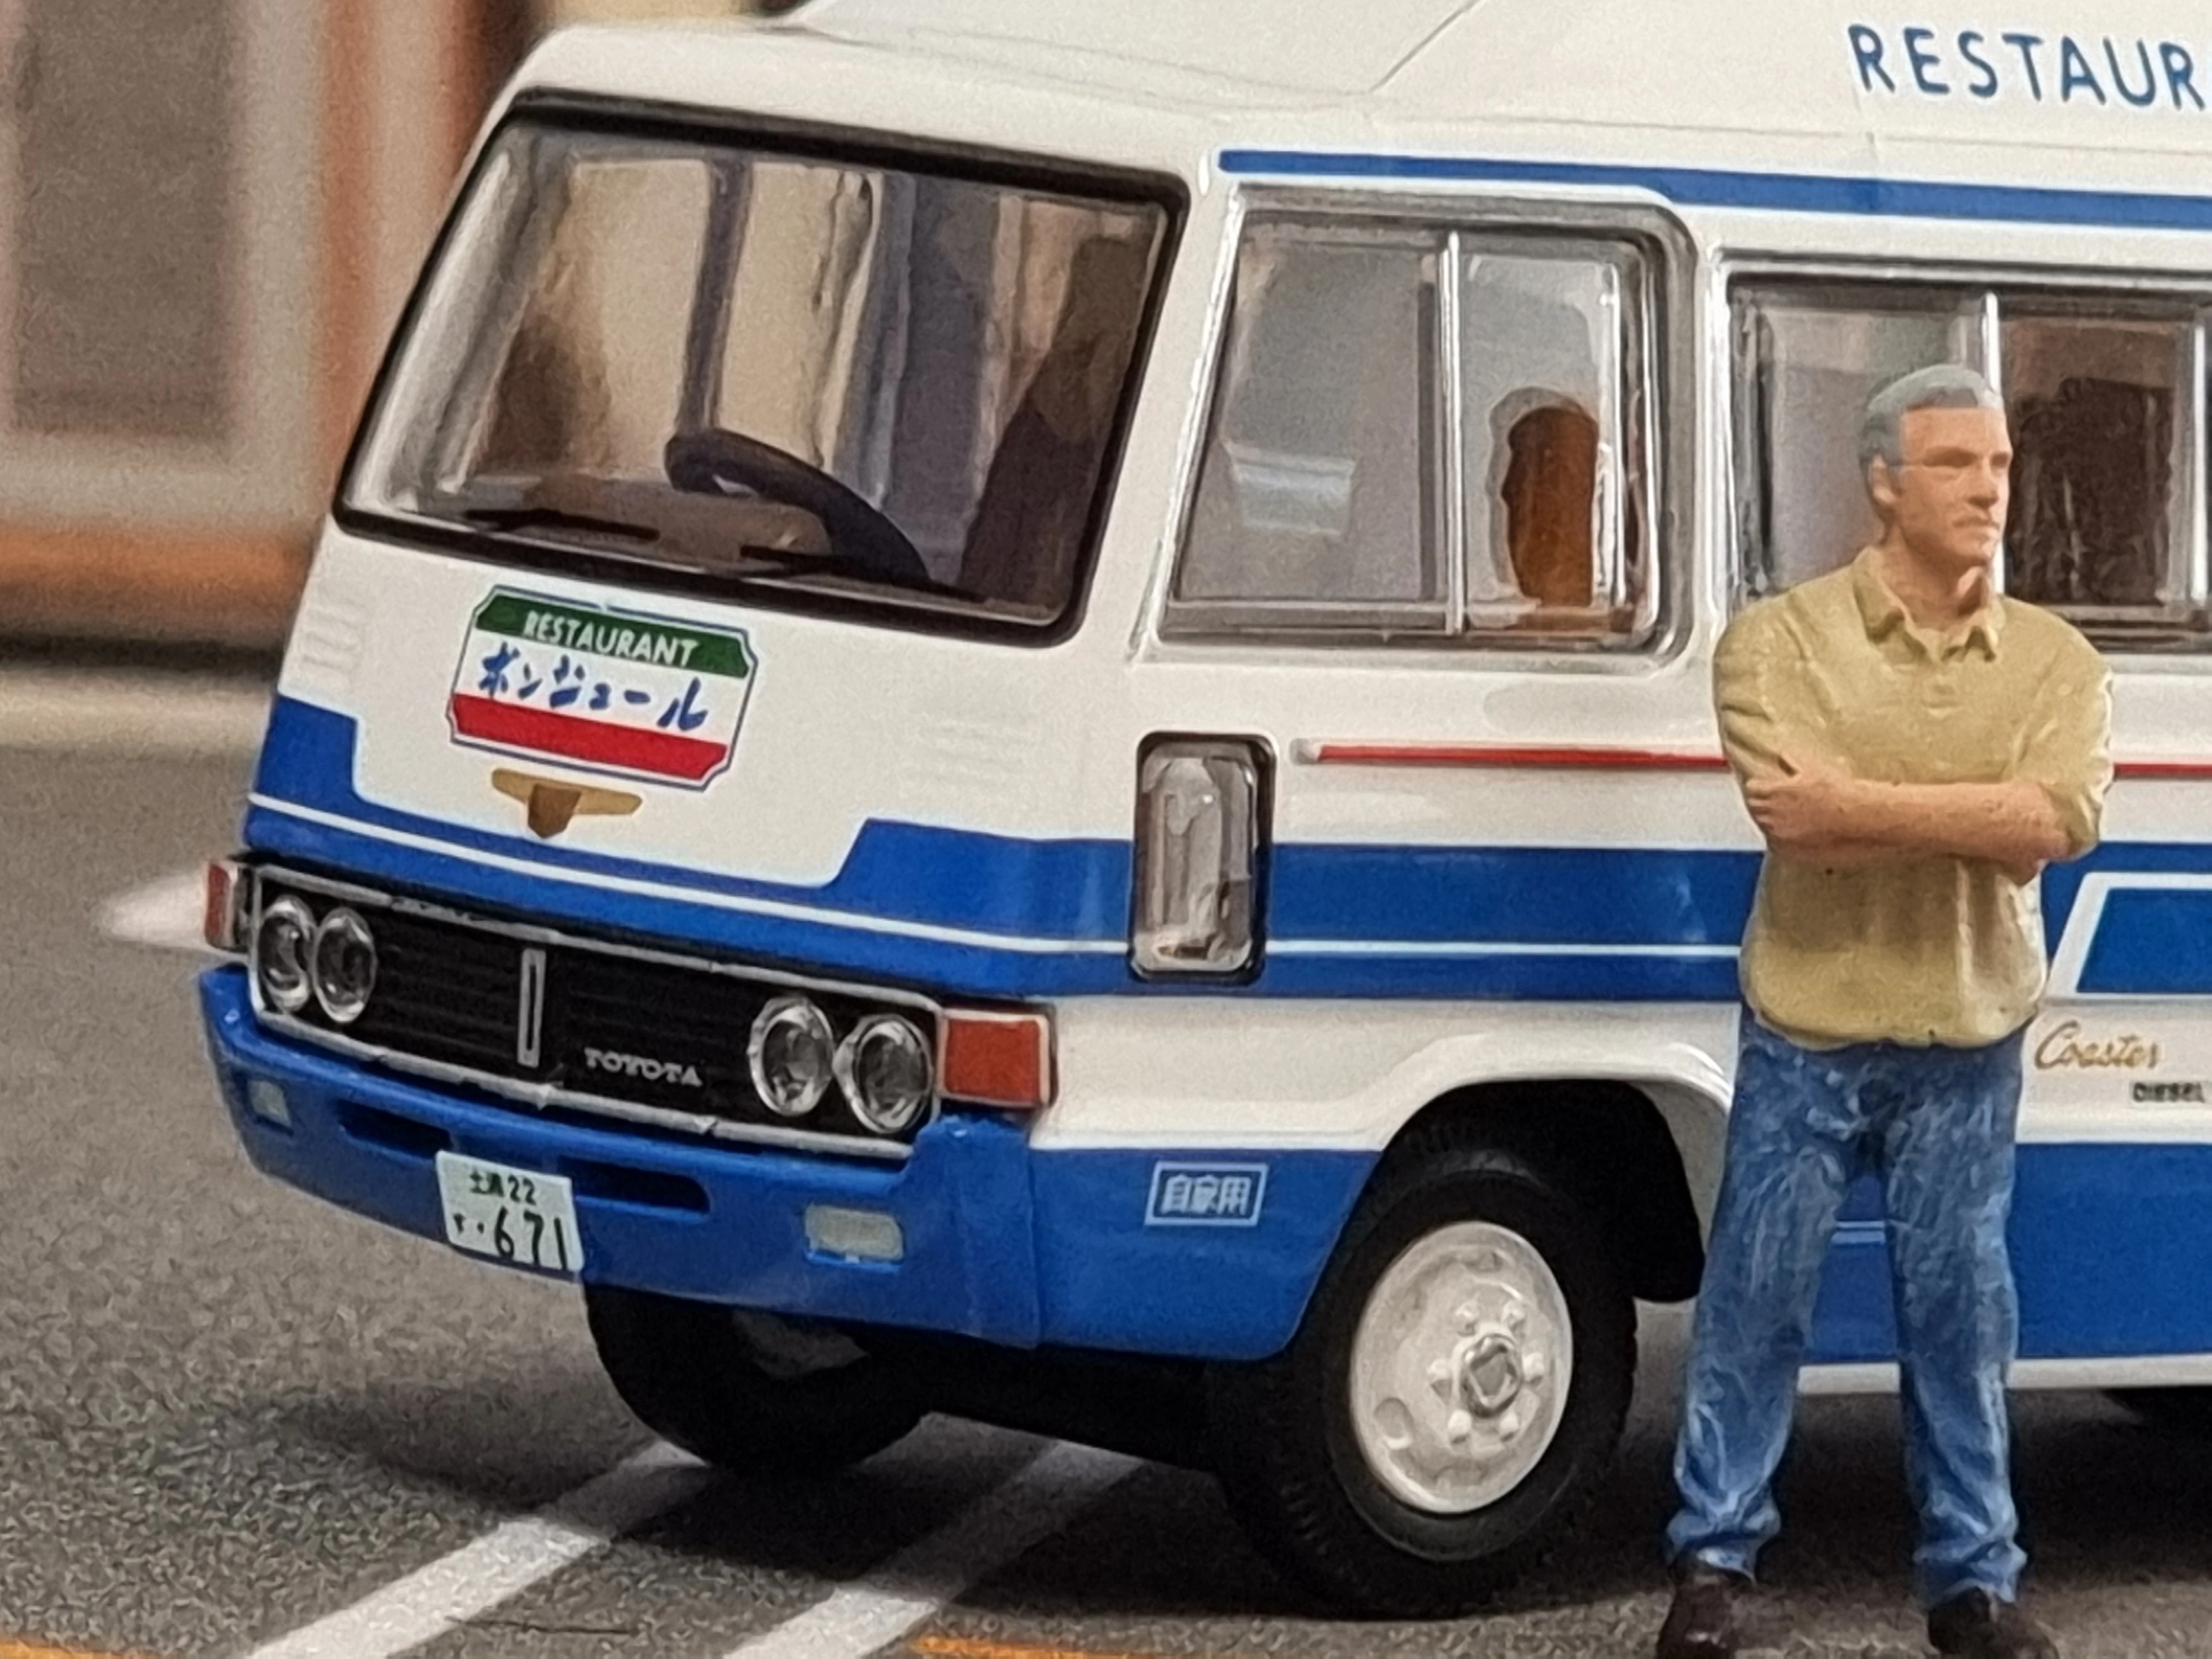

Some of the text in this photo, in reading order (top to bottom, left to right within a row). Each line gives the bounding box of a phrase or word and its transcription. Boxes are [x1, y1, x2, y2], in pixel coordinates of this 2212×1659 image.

[1848, 24, 2205, 111] RESTAUR
[523, 609, 700, 667] RESTAURANT
[478, 641, 708, 731] ボンジュール
[584, 1047, 703, 1087] TOYOTA
